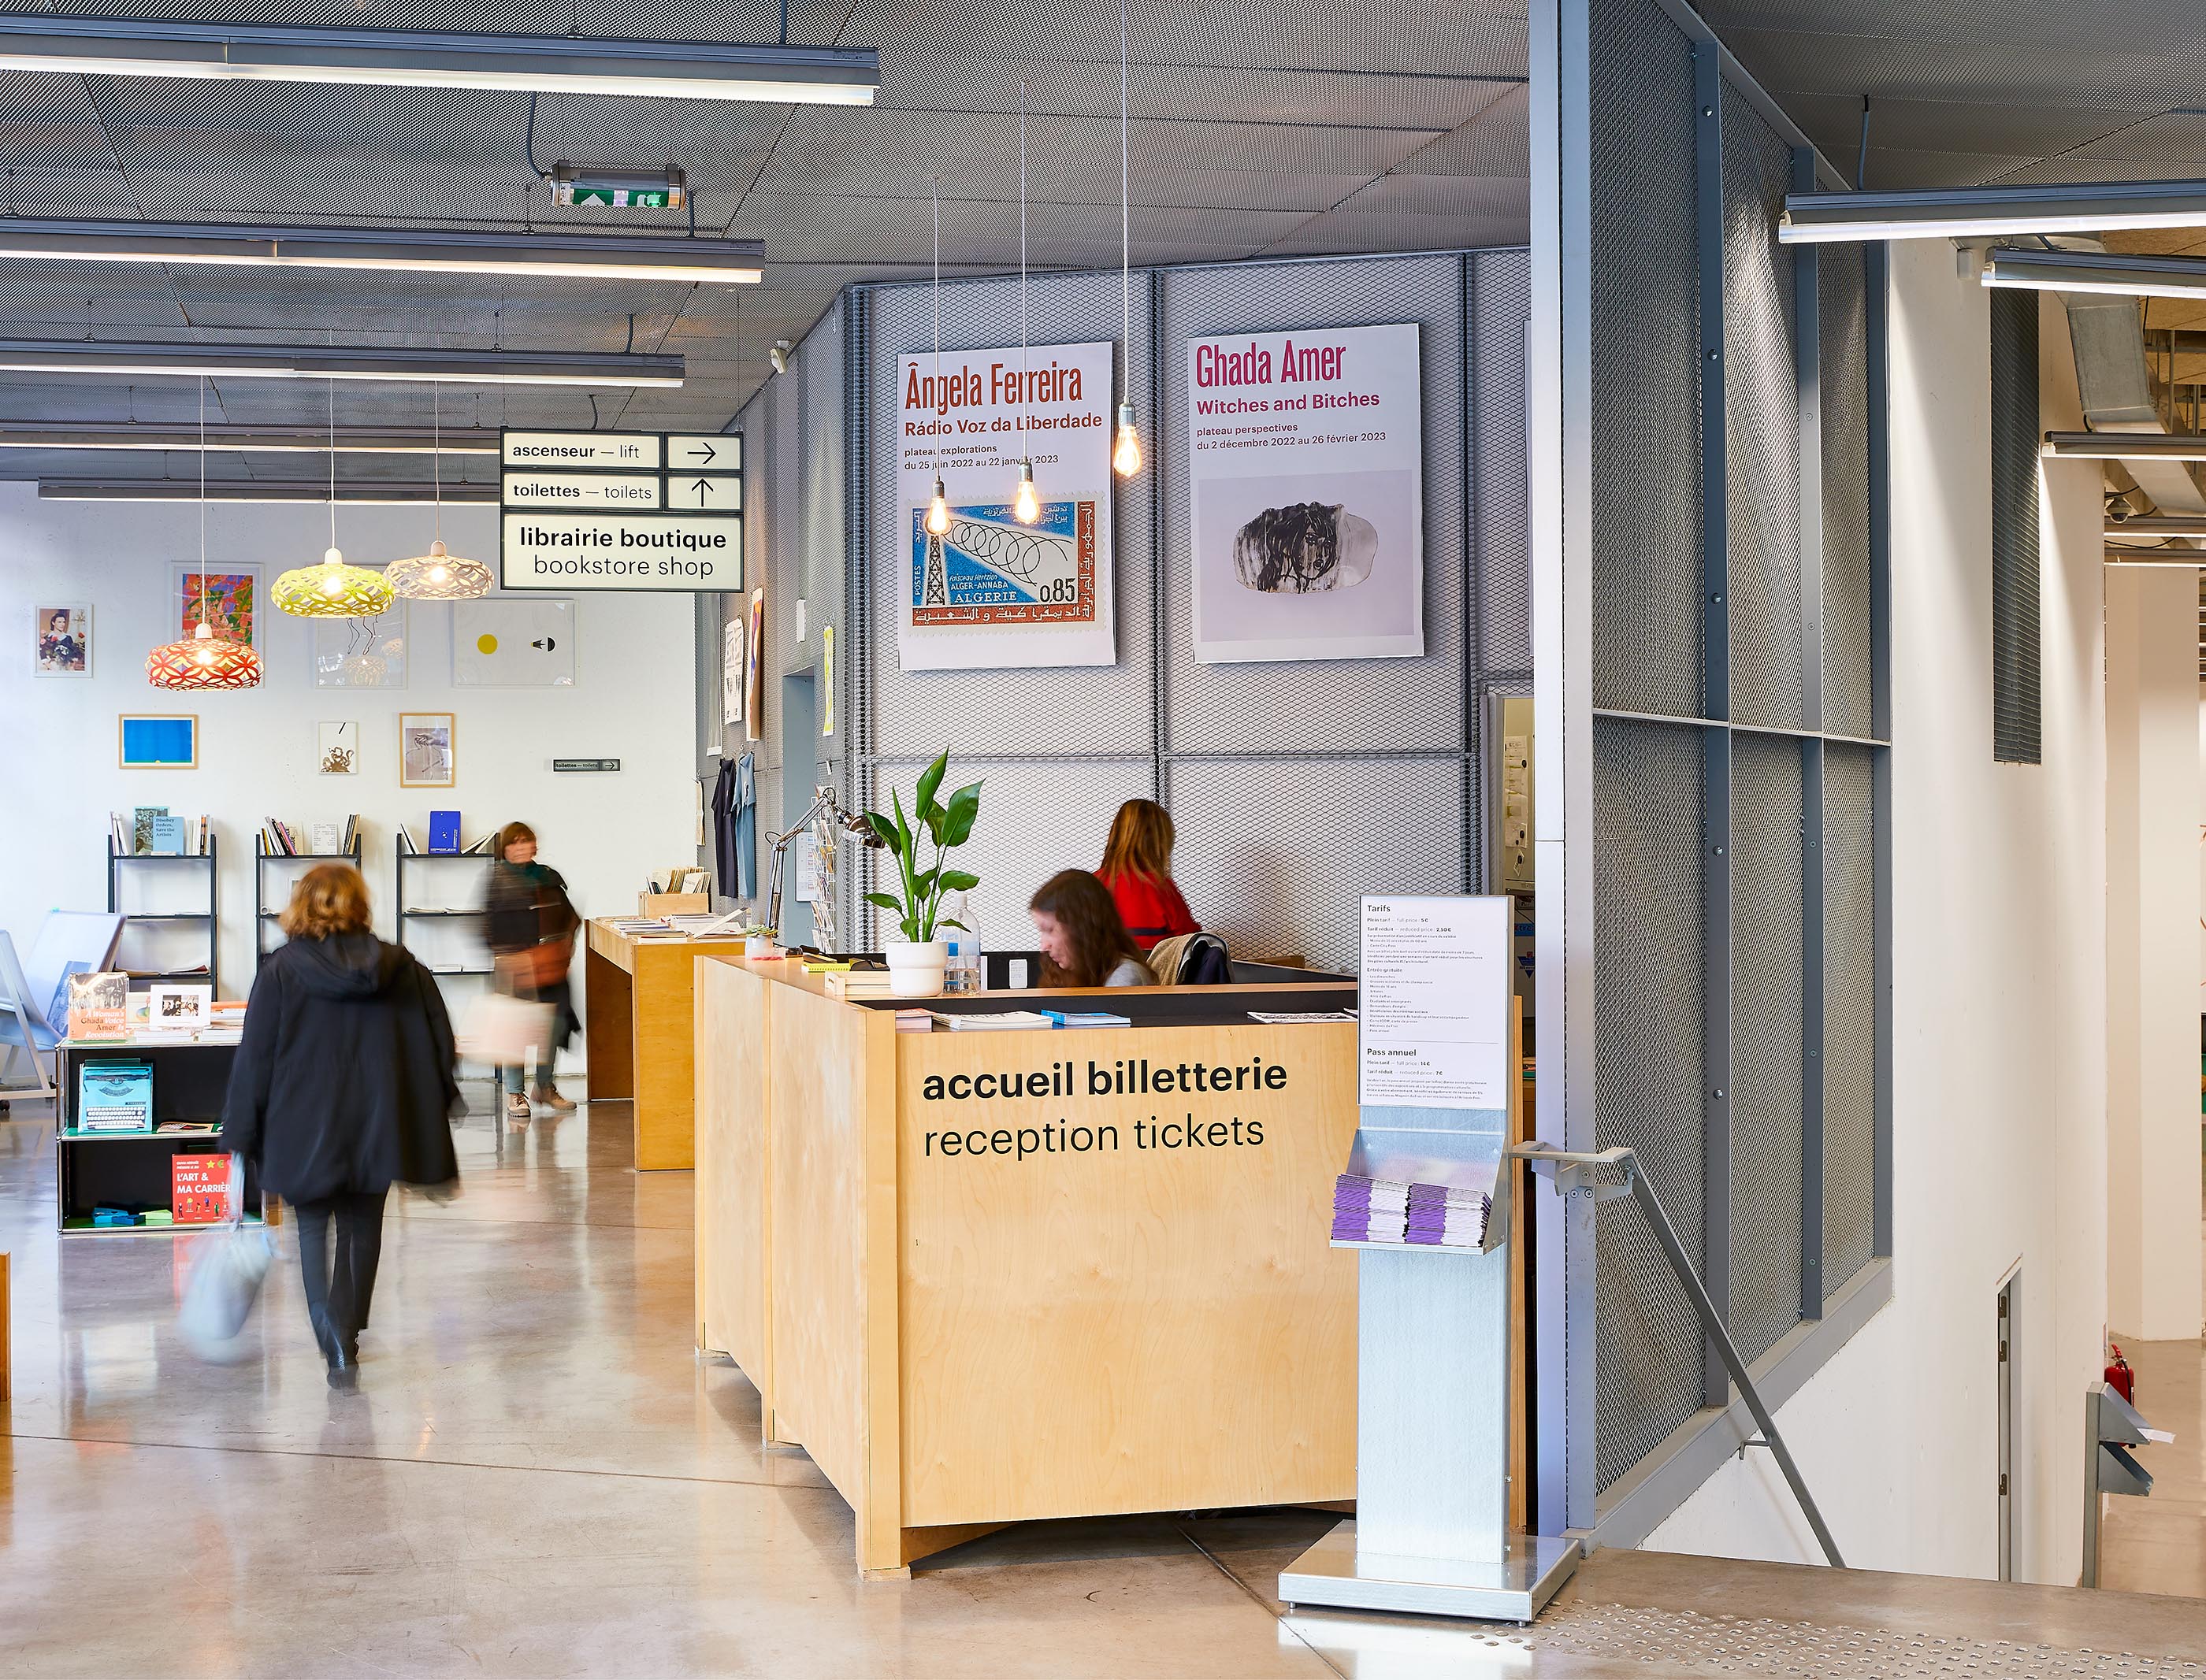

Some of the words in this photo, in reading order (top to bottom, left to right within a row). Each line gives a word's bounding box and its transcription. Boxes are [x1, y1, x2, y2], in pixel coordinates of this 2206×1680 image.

[1196, 342, 1272, 388] Ghada
[1280, 339, 1346, 383] Amer
[905, 362, 983, 416] Ângela
[991, 361, 1083, 406] Ferreira
[1197, 397, 1269, 415] Witches
[1273, 395, 1307, 411] and
[1313, 391, 1380, 410] Bitches
[905, 418, 953, 436] Rádio
[957, 418, 986, 434] Voz
[991, 416, 1011, 432] da
[1016, 412, 1103, 431] Liberdade
[1197, 426, 1233, 438] plateau
[1235, 423, 1298, 436] perspectives
[1197, 441, 1209, 450] du
[1211, 440, 1217, 449] 2
[1220, 438, 1268, 449] décembre
[1271, 436, 1296, 446] 2022
[1312, 435, 1324, 444] 26
[1327, 433, 1359, 443] février
[1361, 432, 1386, 441] 2023
[513, 446, 596, 458] ascenseur
[619, 444, 640, 458] lift
[904, 448, 937, 458] plateau
[941, 445, 997, 456] explorations
[951, 458, 973, 468] 2022
[1034, 454, 1059, 464] 2023
[513, 483, 581, 497] toilettes
[604, 485, 652, 499] toilets
[520, 526, 613, 547] librairie
[620, 528, 726, 551] boutique
[534, 554, 650, 575] bookstore
[658, 555, 714, 579] shop
[951, 580, 1008, 591] ALGER-ANNABA
[1039, 577, 1075, 603] 0,85
[954, 591, 1017, 603] ALGERIE
[923, 1061, 1073, 1100] accueil
[1088, 1056, 1287, 1096] billetterie
[926, 1118, 1119, 1162] reception
[1134, 1113, 1265, 1150] tickets
[176, 1172, 199, 1181] L'ART
[201, 1172, 209, 1181] &
[176, 1185, 193, 1194] MA
[195, 1181, 231, 1193] CARRIÈR
